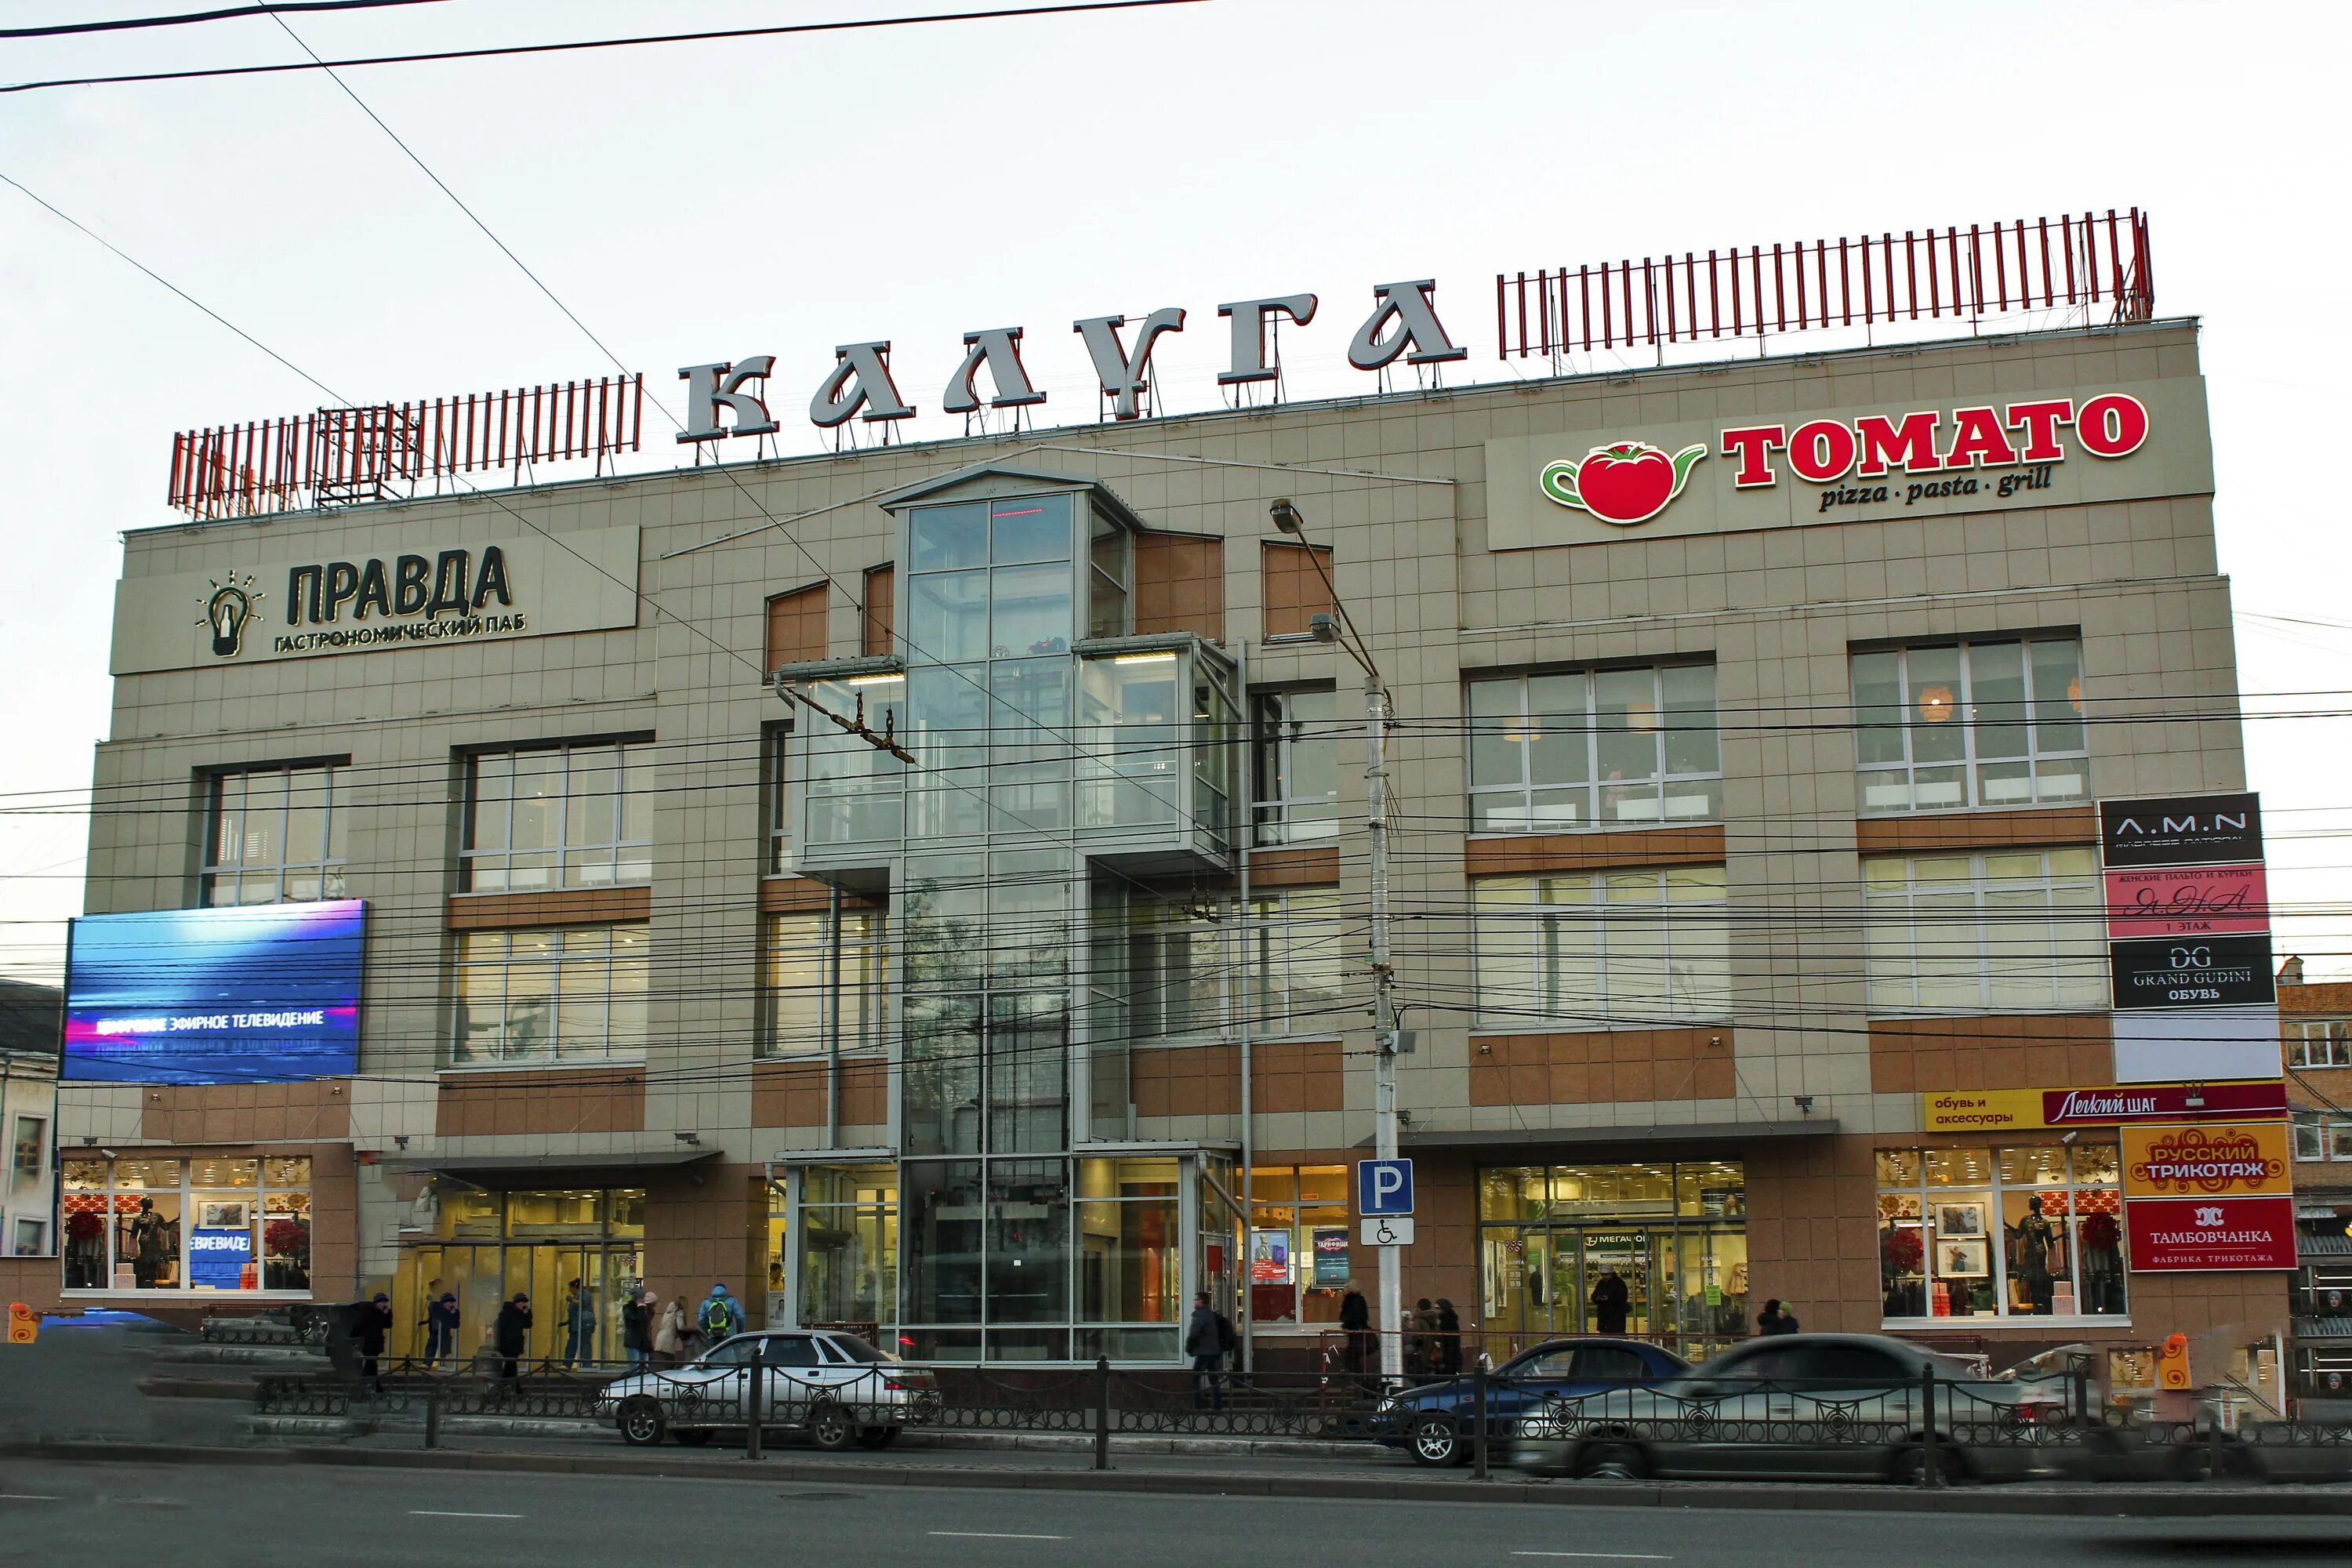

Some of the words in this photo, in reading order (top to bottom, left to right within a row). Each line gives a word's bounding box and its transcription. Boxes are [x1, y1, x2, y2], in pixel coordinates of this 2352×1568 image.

[677, 278, 1467, 443] КАЛУГА
[1720, 392, 2150, 488] TOMATO
[1819, 484, 1887, 512] pizza
[1905, 475, 1977, 505] pasta
[1998, 464, 2051, 497] grill
[287, 546, 510, 626] ПРАВДА
[274, 615, 481, 652] ГАСТРОНОМИЧЕСКИЙ
[485, 613, 527, 633] ПАБ
[2119, 873, 2161, 883] ЖЕНСКИЕ
[2165, 871, 2202, 881] ПАЛЬТО
[2166, 923, 2171, 931] 1
[2177, 921, 2211, 931] ЭТАЖ
[2134, 972, 2190, 986] GRAND
[2194, 971, 2252, 984] GUDINI
[2169, 989, 2220, 1000] ОБУВЬ
[169, 1015, 229, 1031] ЭФИРНОЕ
[231, 1011, 324, 1029] ТЕЛЕВИДЕНИЕ
[1935, 1098, 1974, 1110] обувь
[2050, 1091, 2125, 1123] Легкий
[1936, 1112, 2013, 1124] аксессуары
[2154, 1142, 2256, 1161] РУССКИЙ
[2147, 1162, 2265, 1179] ТРИКОТАЖ
[1374, 1166, 1403, 1208] P
[2150, 1230, 2272, 1244] ТАМБОВЧАНКА
